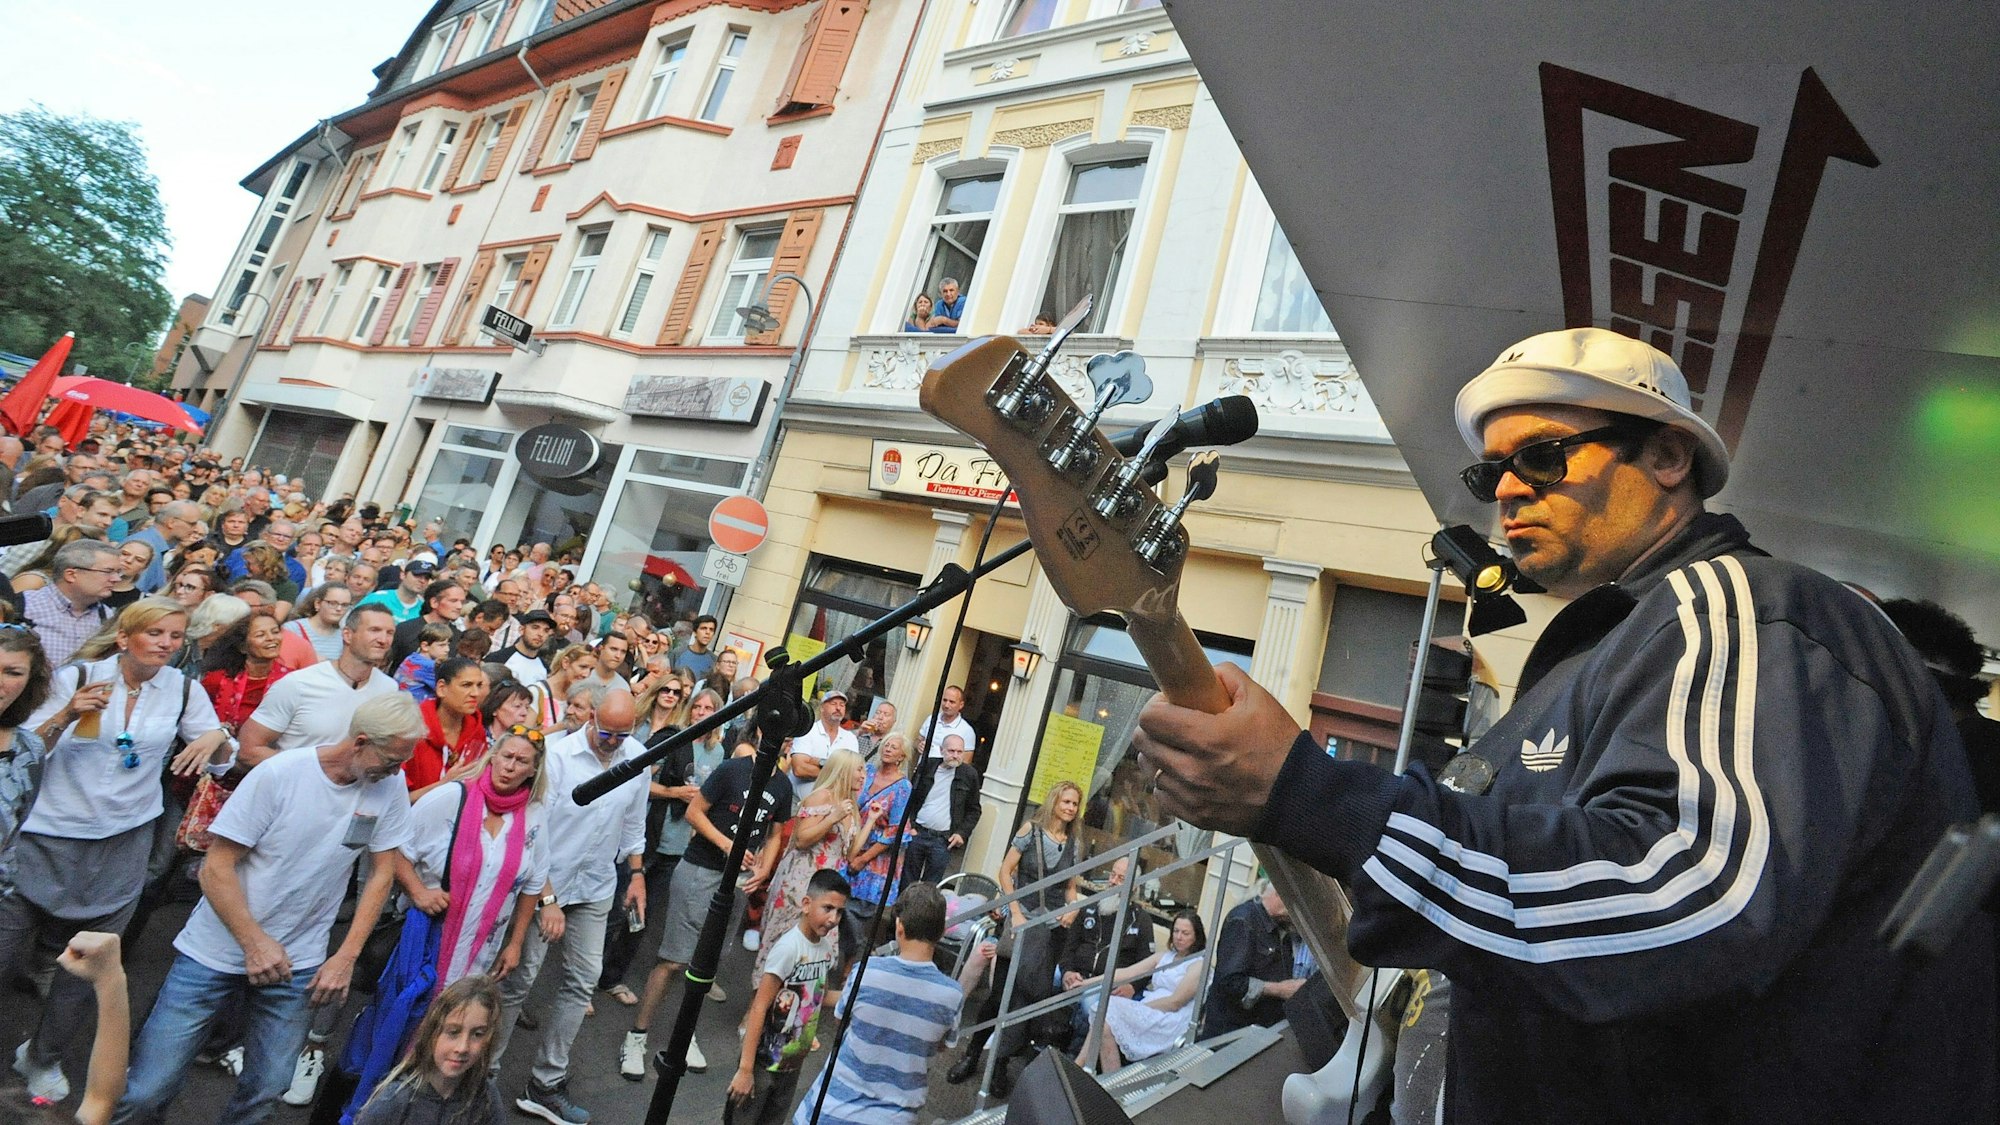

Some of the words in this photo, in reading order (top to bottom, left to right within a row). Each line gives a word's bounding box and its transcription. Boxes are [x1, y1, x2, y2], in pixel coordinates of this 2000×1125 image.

[492, 311, 525, 337] FELLINI
[529, 434, 577, 467] FELLINI
[917, 452, 958, 482] Da
[932, 483, 967, 496] Trattoria
[967, 487, 978, 497] &
[978, 489, 1012, 501] Pizzea
[715, 571, 730, 581] frei
